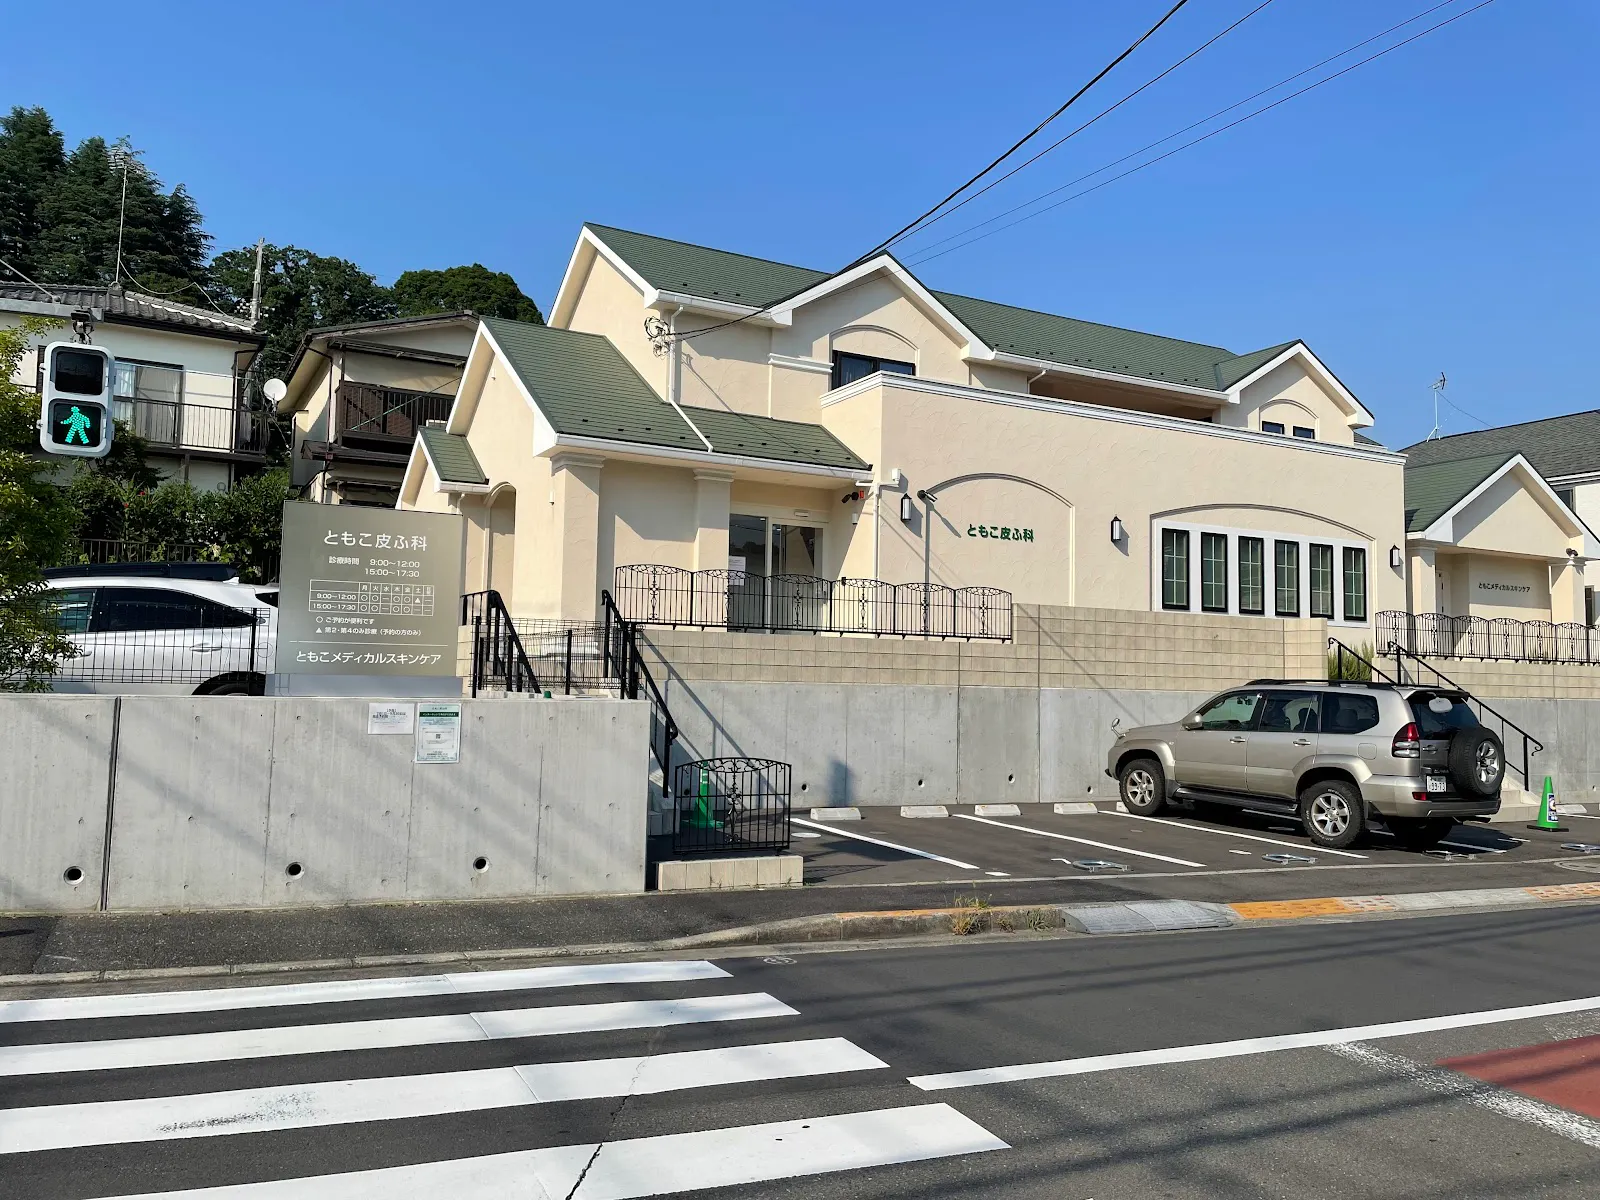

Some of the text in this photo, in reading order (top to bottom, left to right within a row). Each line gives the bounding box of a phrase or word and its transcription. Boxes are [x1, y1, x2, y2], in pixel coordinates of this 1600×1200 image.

[323, 529, 427, 551] ともこ皮ふ科
[967, 523, 1034, 543] ともこ皮ふ科
[328, 556, 360, 566] 診療時間
[1478, 582, 1531, 593] ともこメディカルスキンケア
[295, 650, 442, 665] ともこメディカルスキンケア
